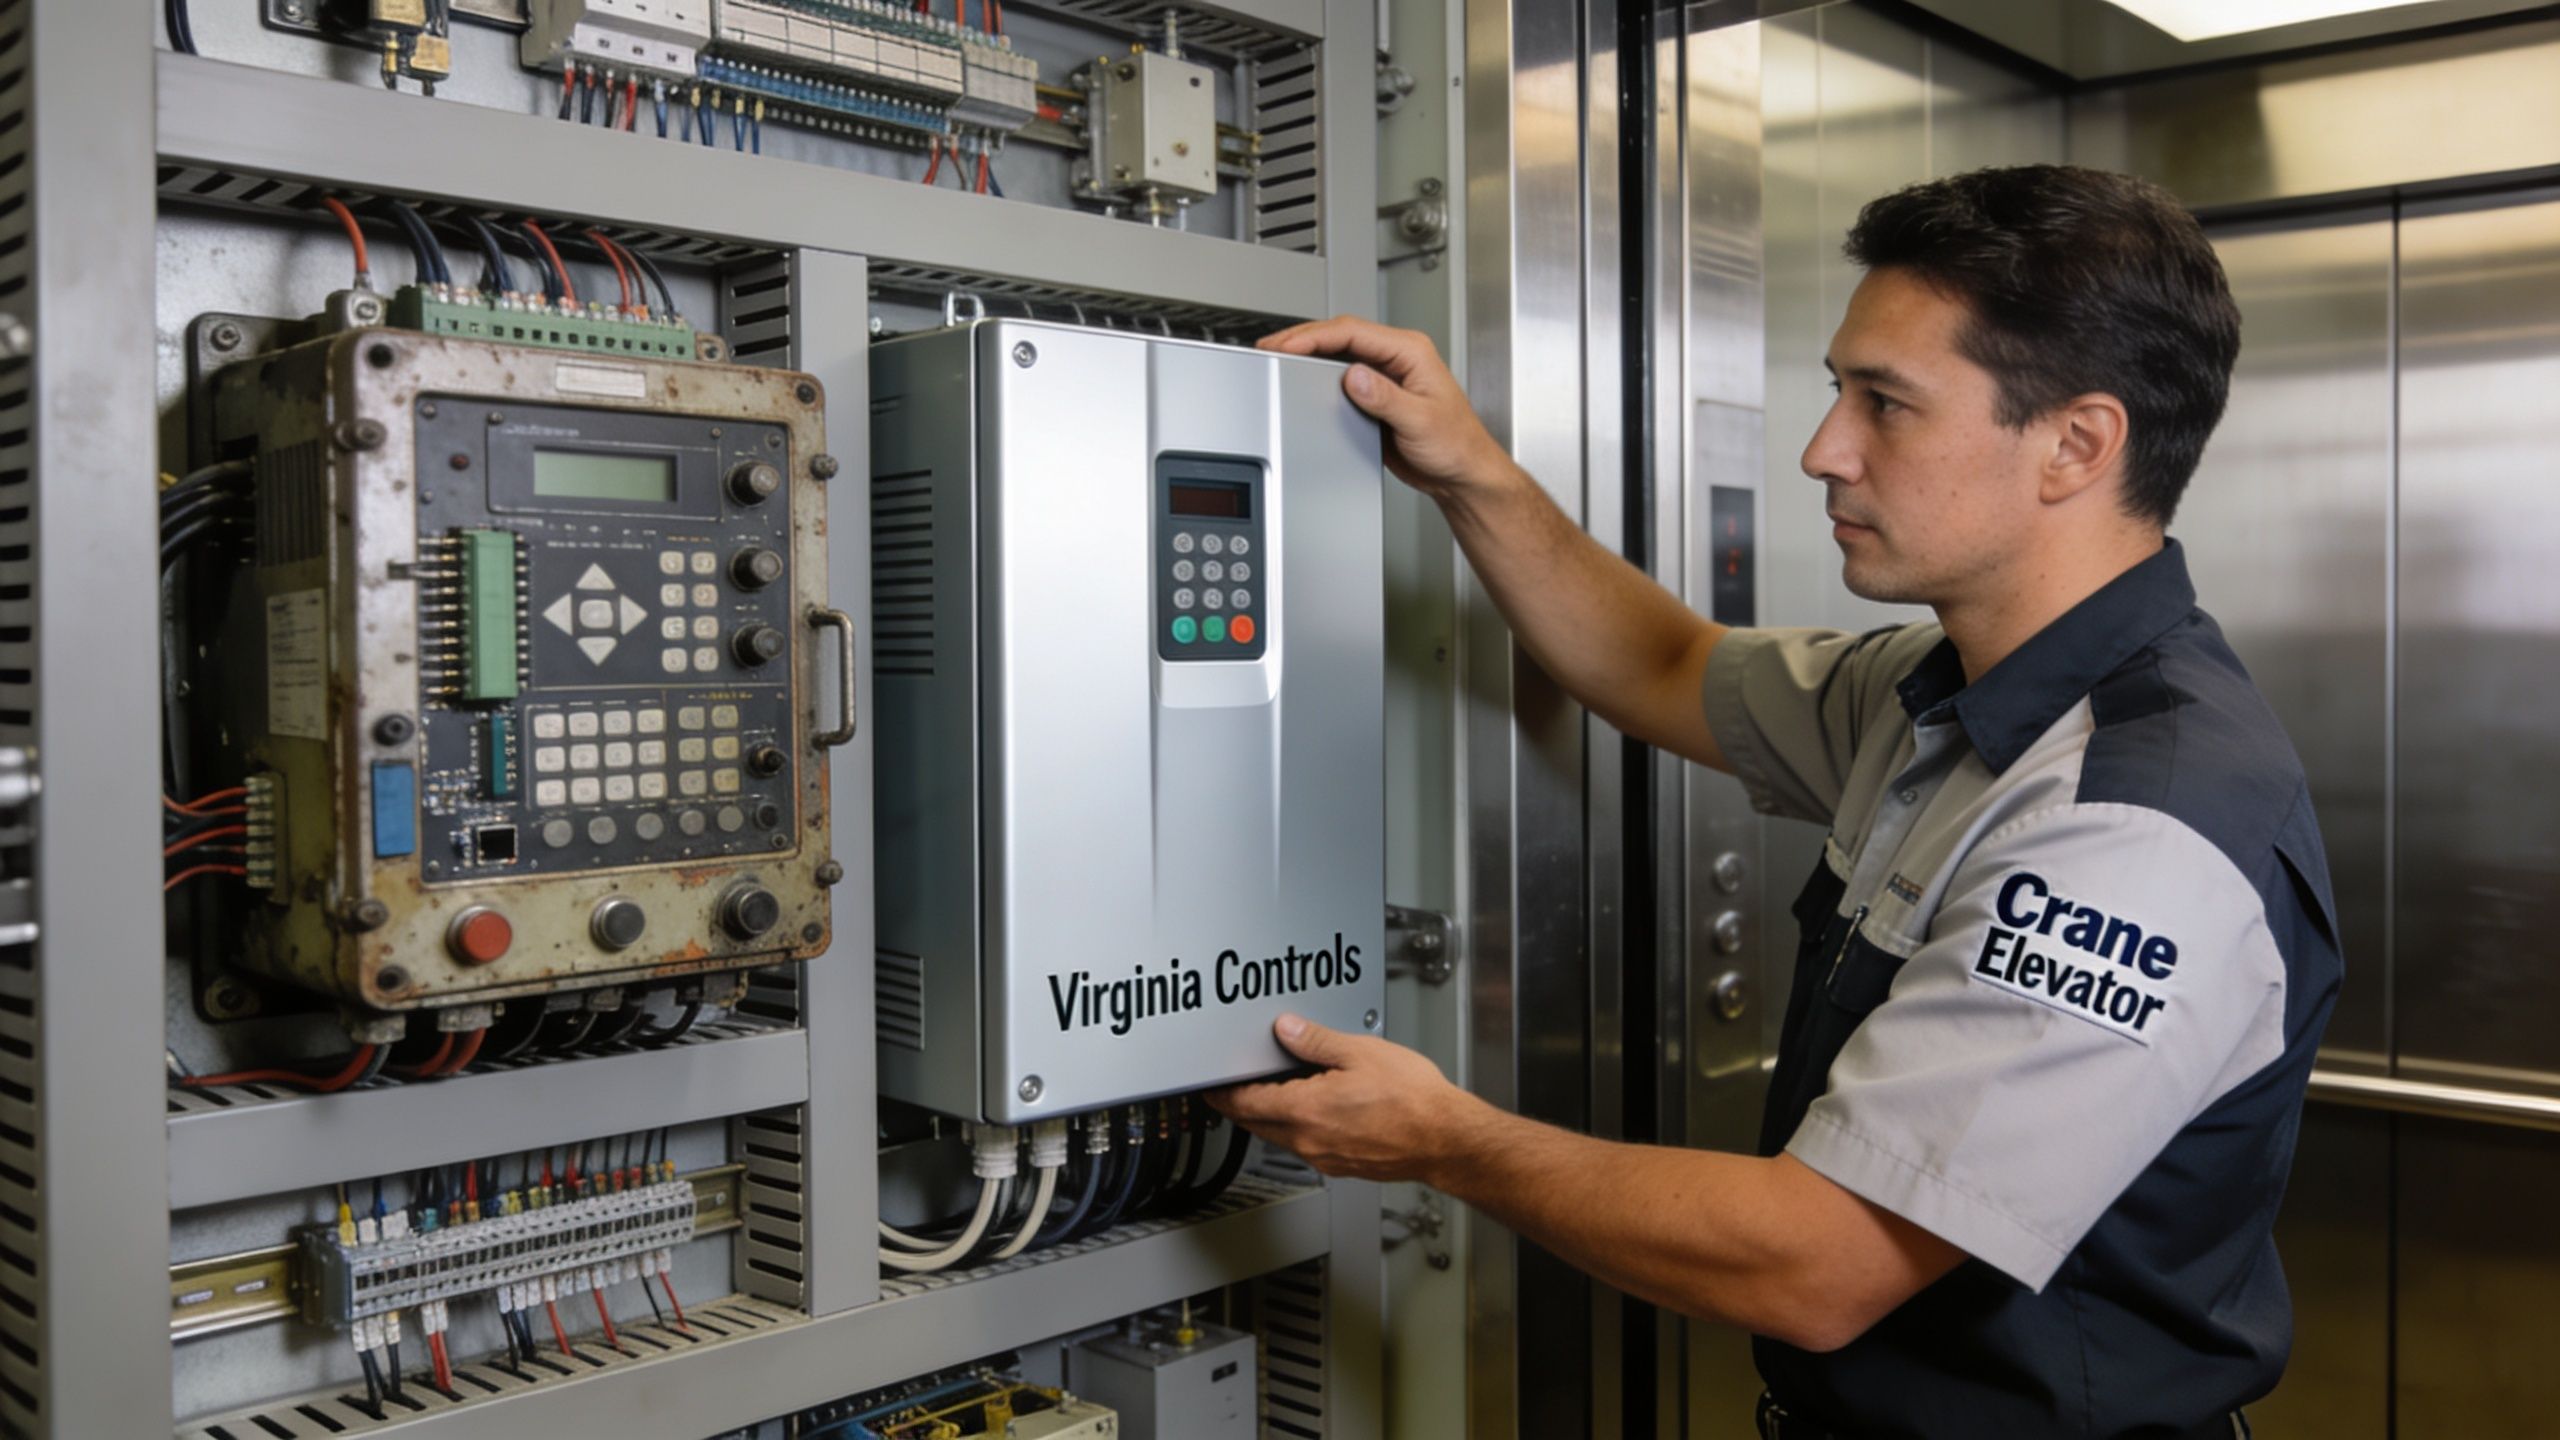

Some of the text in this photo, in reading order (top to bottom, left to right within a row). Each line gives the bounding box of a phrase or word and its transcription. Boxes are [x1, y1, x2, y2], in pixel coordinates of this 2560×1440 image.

[1974, 925, 2166, 1032] Elevator
[1996, 871, 2179, 981] Crane
[1048, 932, 1362, 1036] Virginia Controls
